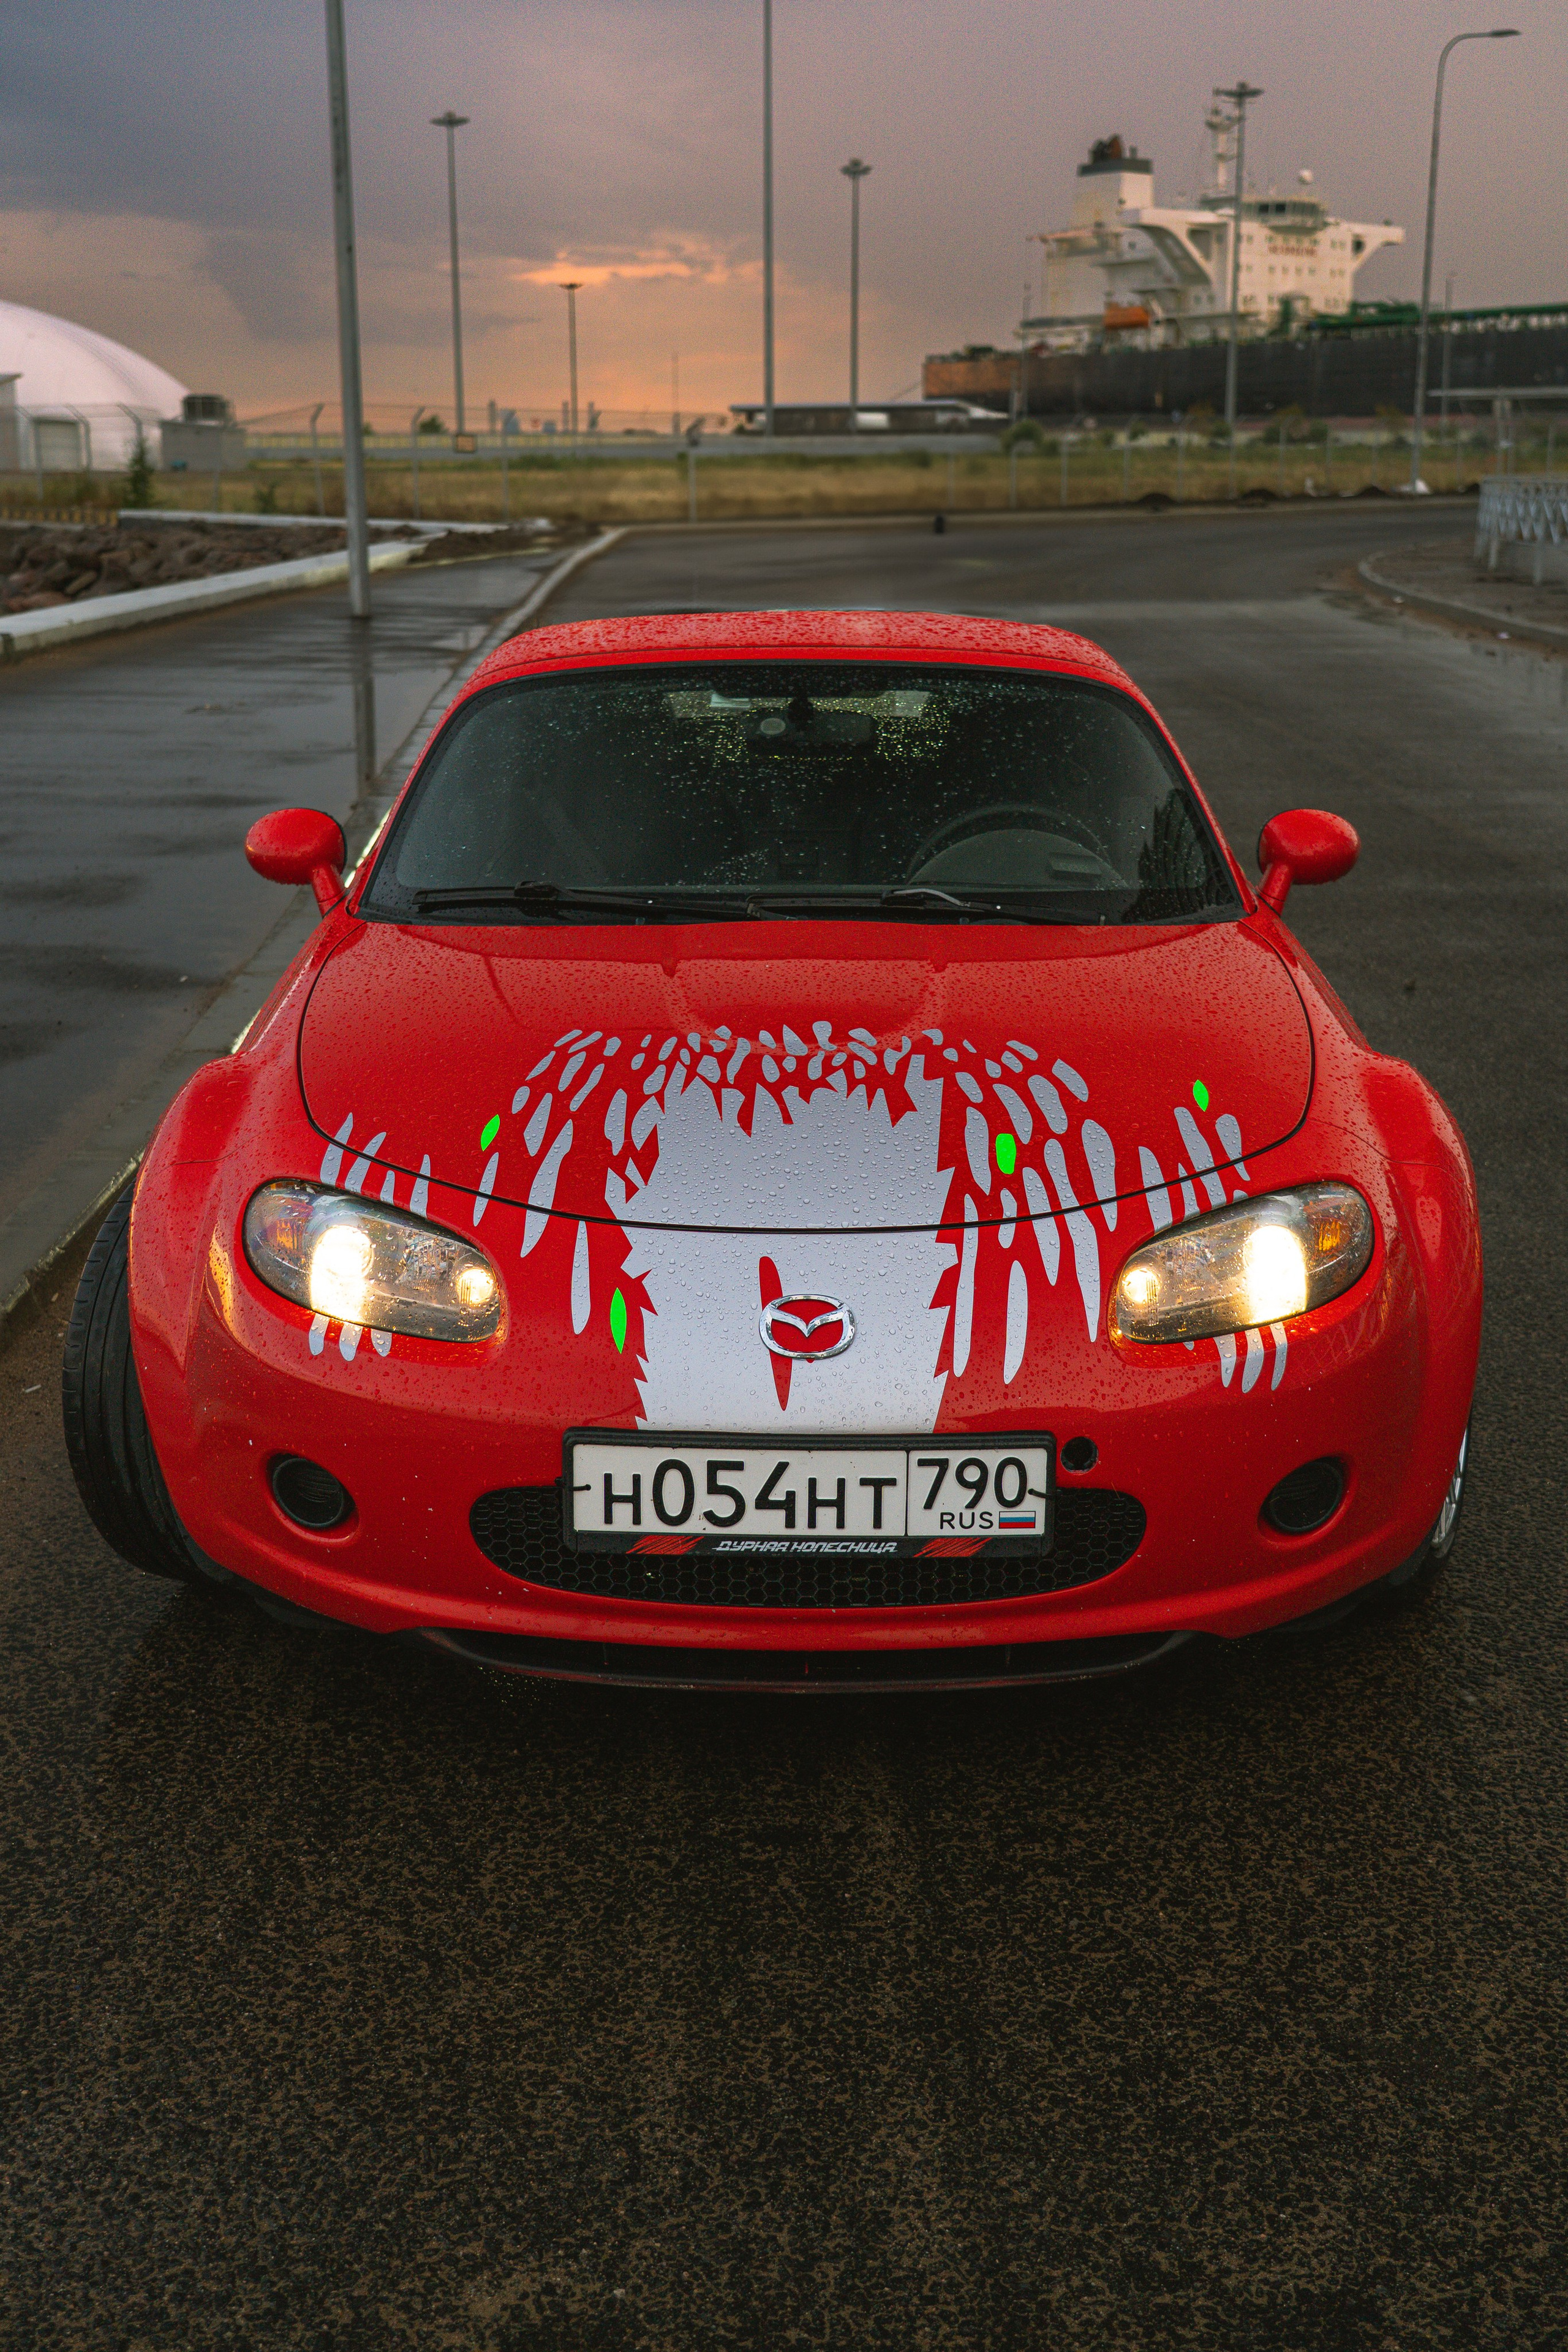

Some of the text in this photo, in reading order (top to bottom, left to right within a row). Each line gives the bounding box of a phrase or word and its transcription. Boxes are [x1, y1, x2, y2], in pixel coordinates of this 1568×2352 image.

[916, 1457, 1028, 1510] 790
[940, 1511, 995, 1530] RUS
[712, 1540, 898, 1554] ДУРНАЯ КОЛЕСНИЦА
